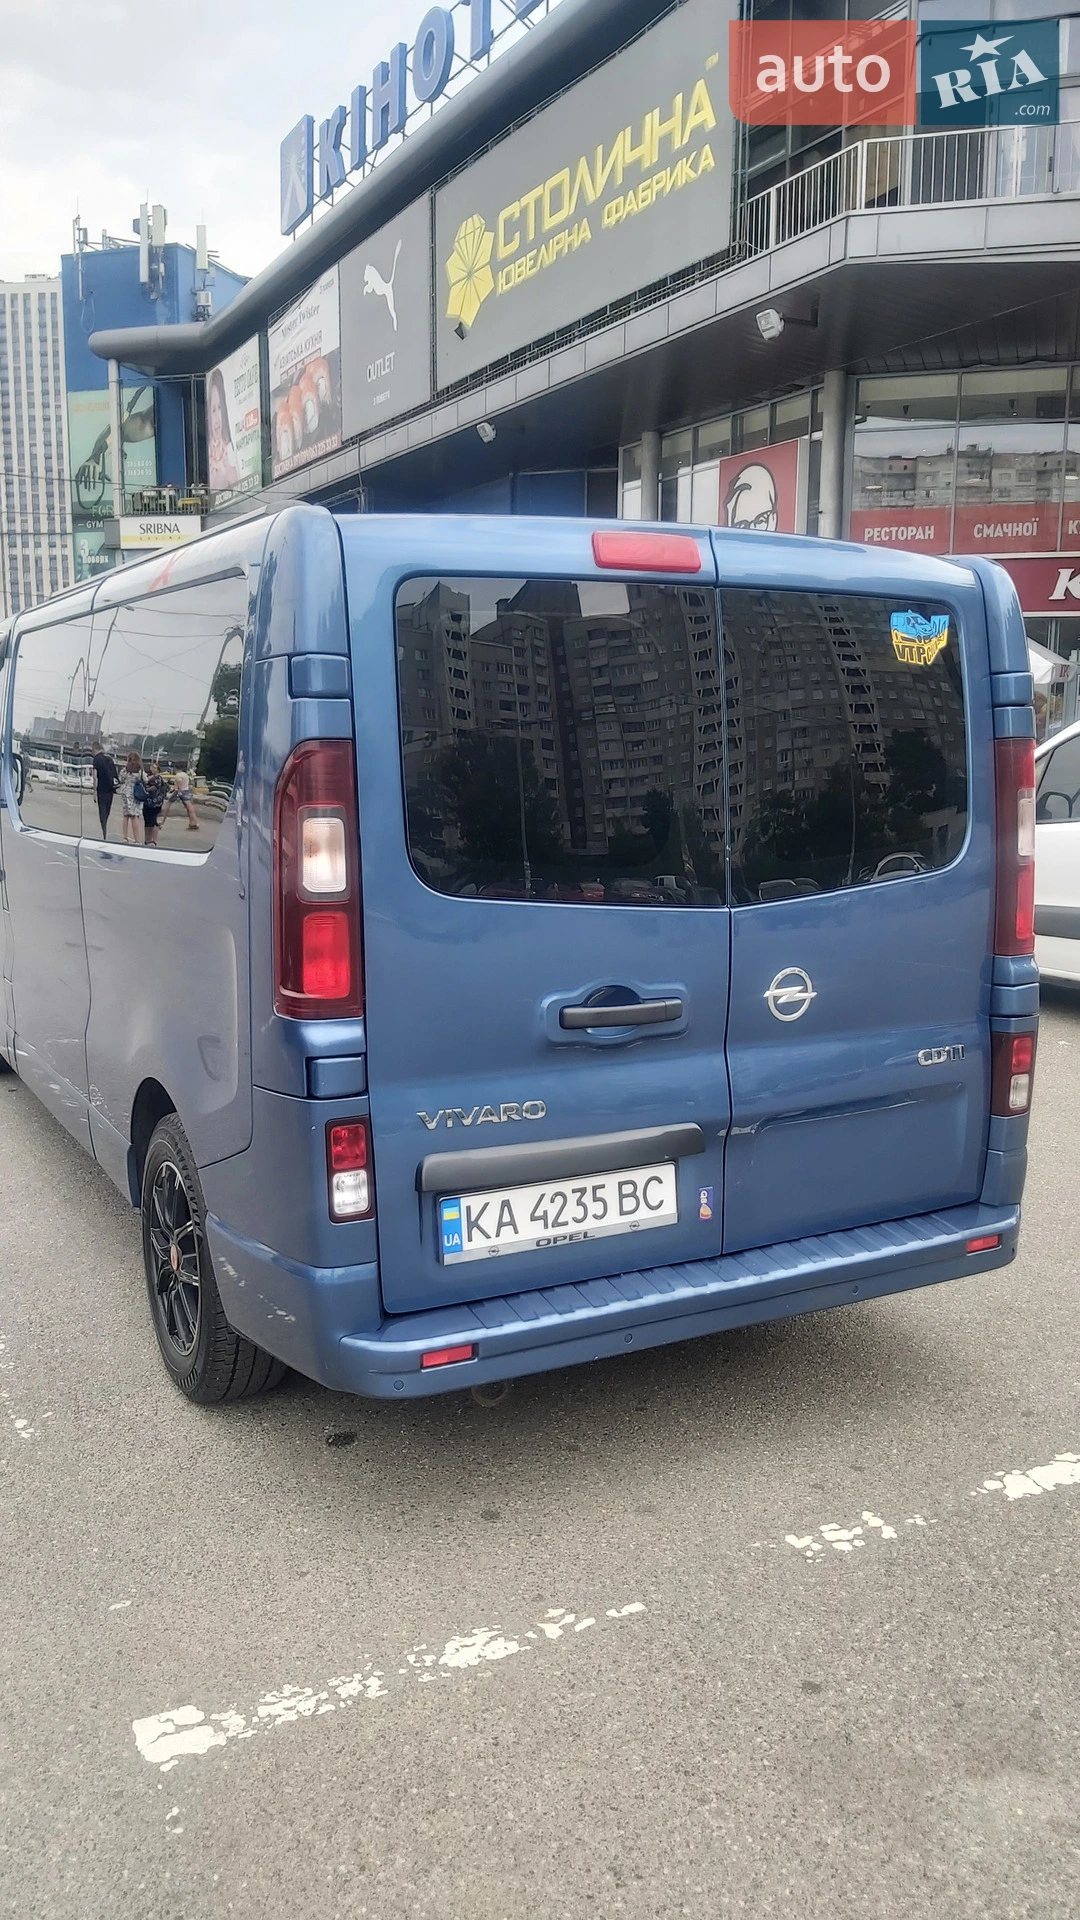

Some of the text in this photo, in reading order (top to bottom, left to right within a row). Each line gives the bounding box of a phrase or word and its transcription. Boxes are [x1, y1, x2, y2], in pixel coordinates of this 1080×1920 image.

[319, 0, 545, 200] КІНОТ
[497, 79, 717, 262] СТОЛИЧНА
[496, 143, 716, 297] ЮВЕЛІРНА ФАБРИКА
[366, 352, 395, 383] OUTLET
[86, 520, 104, 529] GYM
[139, 522, 181, 534] SRIBNA
[864, 525, 934, 542] РЕСТОРАН
[973, 517, 1040, 538] СМАЧНОЇ
[917, 1043, 965, 1066] CDTI
[416, 1099, 547, 1130] VIVARO
[466, 1176, 665, 1243] KA 4235 BC
[444, 1233, 461, 1248] UA
[535, 1231, 596, 1247] OPEL
